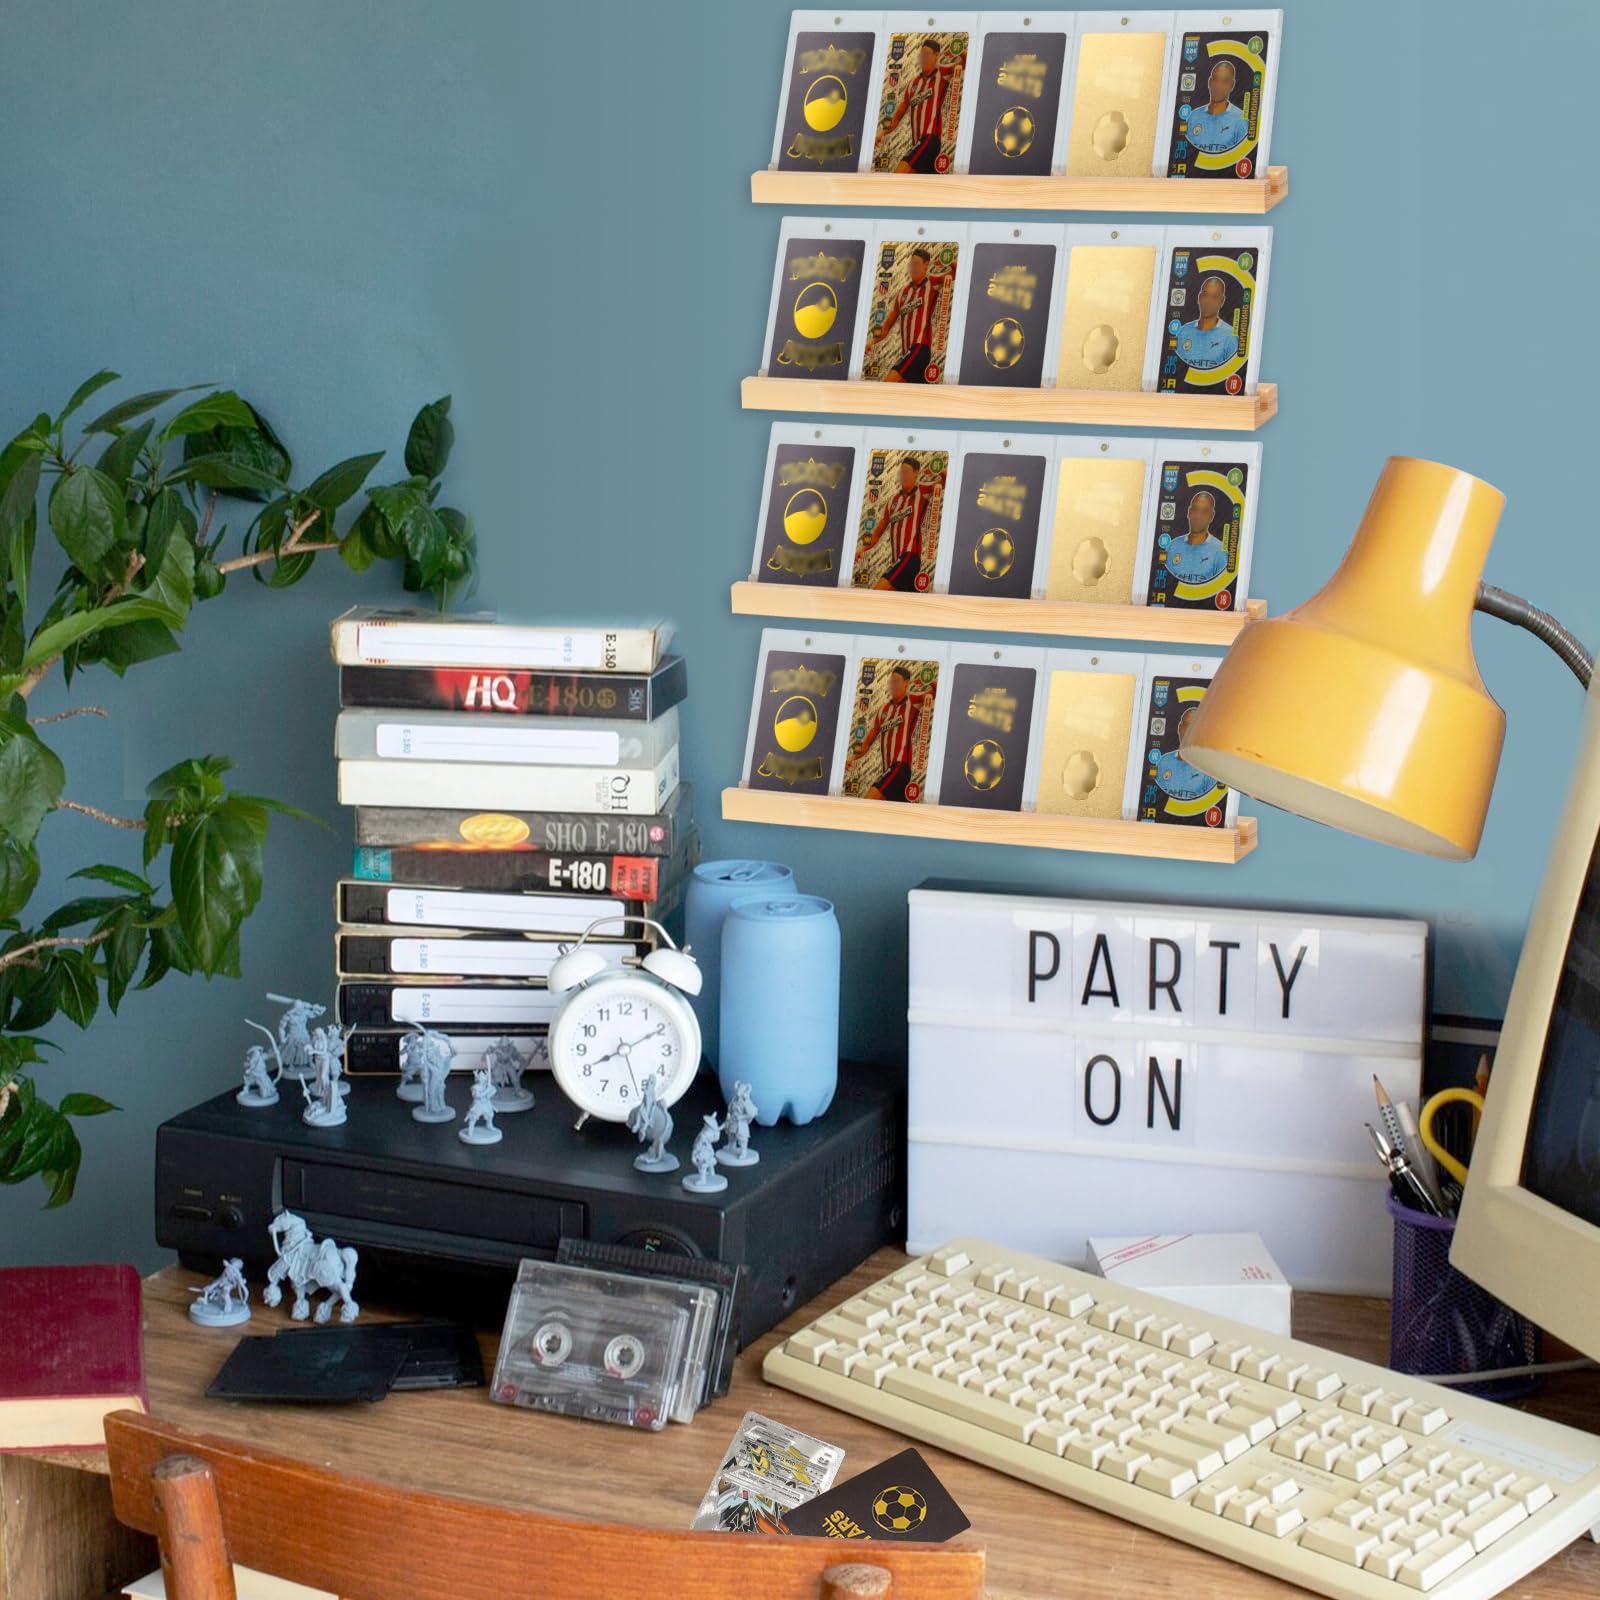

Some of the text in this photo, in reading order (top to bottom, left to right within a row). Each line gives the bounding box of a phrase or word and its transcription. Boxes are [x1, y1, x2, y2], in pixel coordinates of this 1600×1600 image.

[606, 634, 616, 669] E-180
[464, 675, 520, 711] HQ
[611, 775, 630, 810] HQ
[545, 822, 587, 853] SHQ
[596, 822, 648, 854] E-180
[548, 858, 606, 891] E-180
[1028, 930, 1308, 1019] PARTY
[597, 1008, 610, 1022] 11
[617, 1002, 632, 1016] 12
[642, 1008, 648, 1021] 1
[582, 1024, 597, 1038] 10
[656, 1023, 666, 1036] 2
[576, 1044, 587, 1056] 9
[662, 1044, 672, 1056] 3
[582, 1064, 592, 1076] 8
[656, 1064, 666, 1076] 4
[600, 1080, 608, 1092] 7
[620, 1084, 628, 1098] 6
[642, 1080, 649, 1092] 5
[1083, 1054, 1182, 1131] ON
